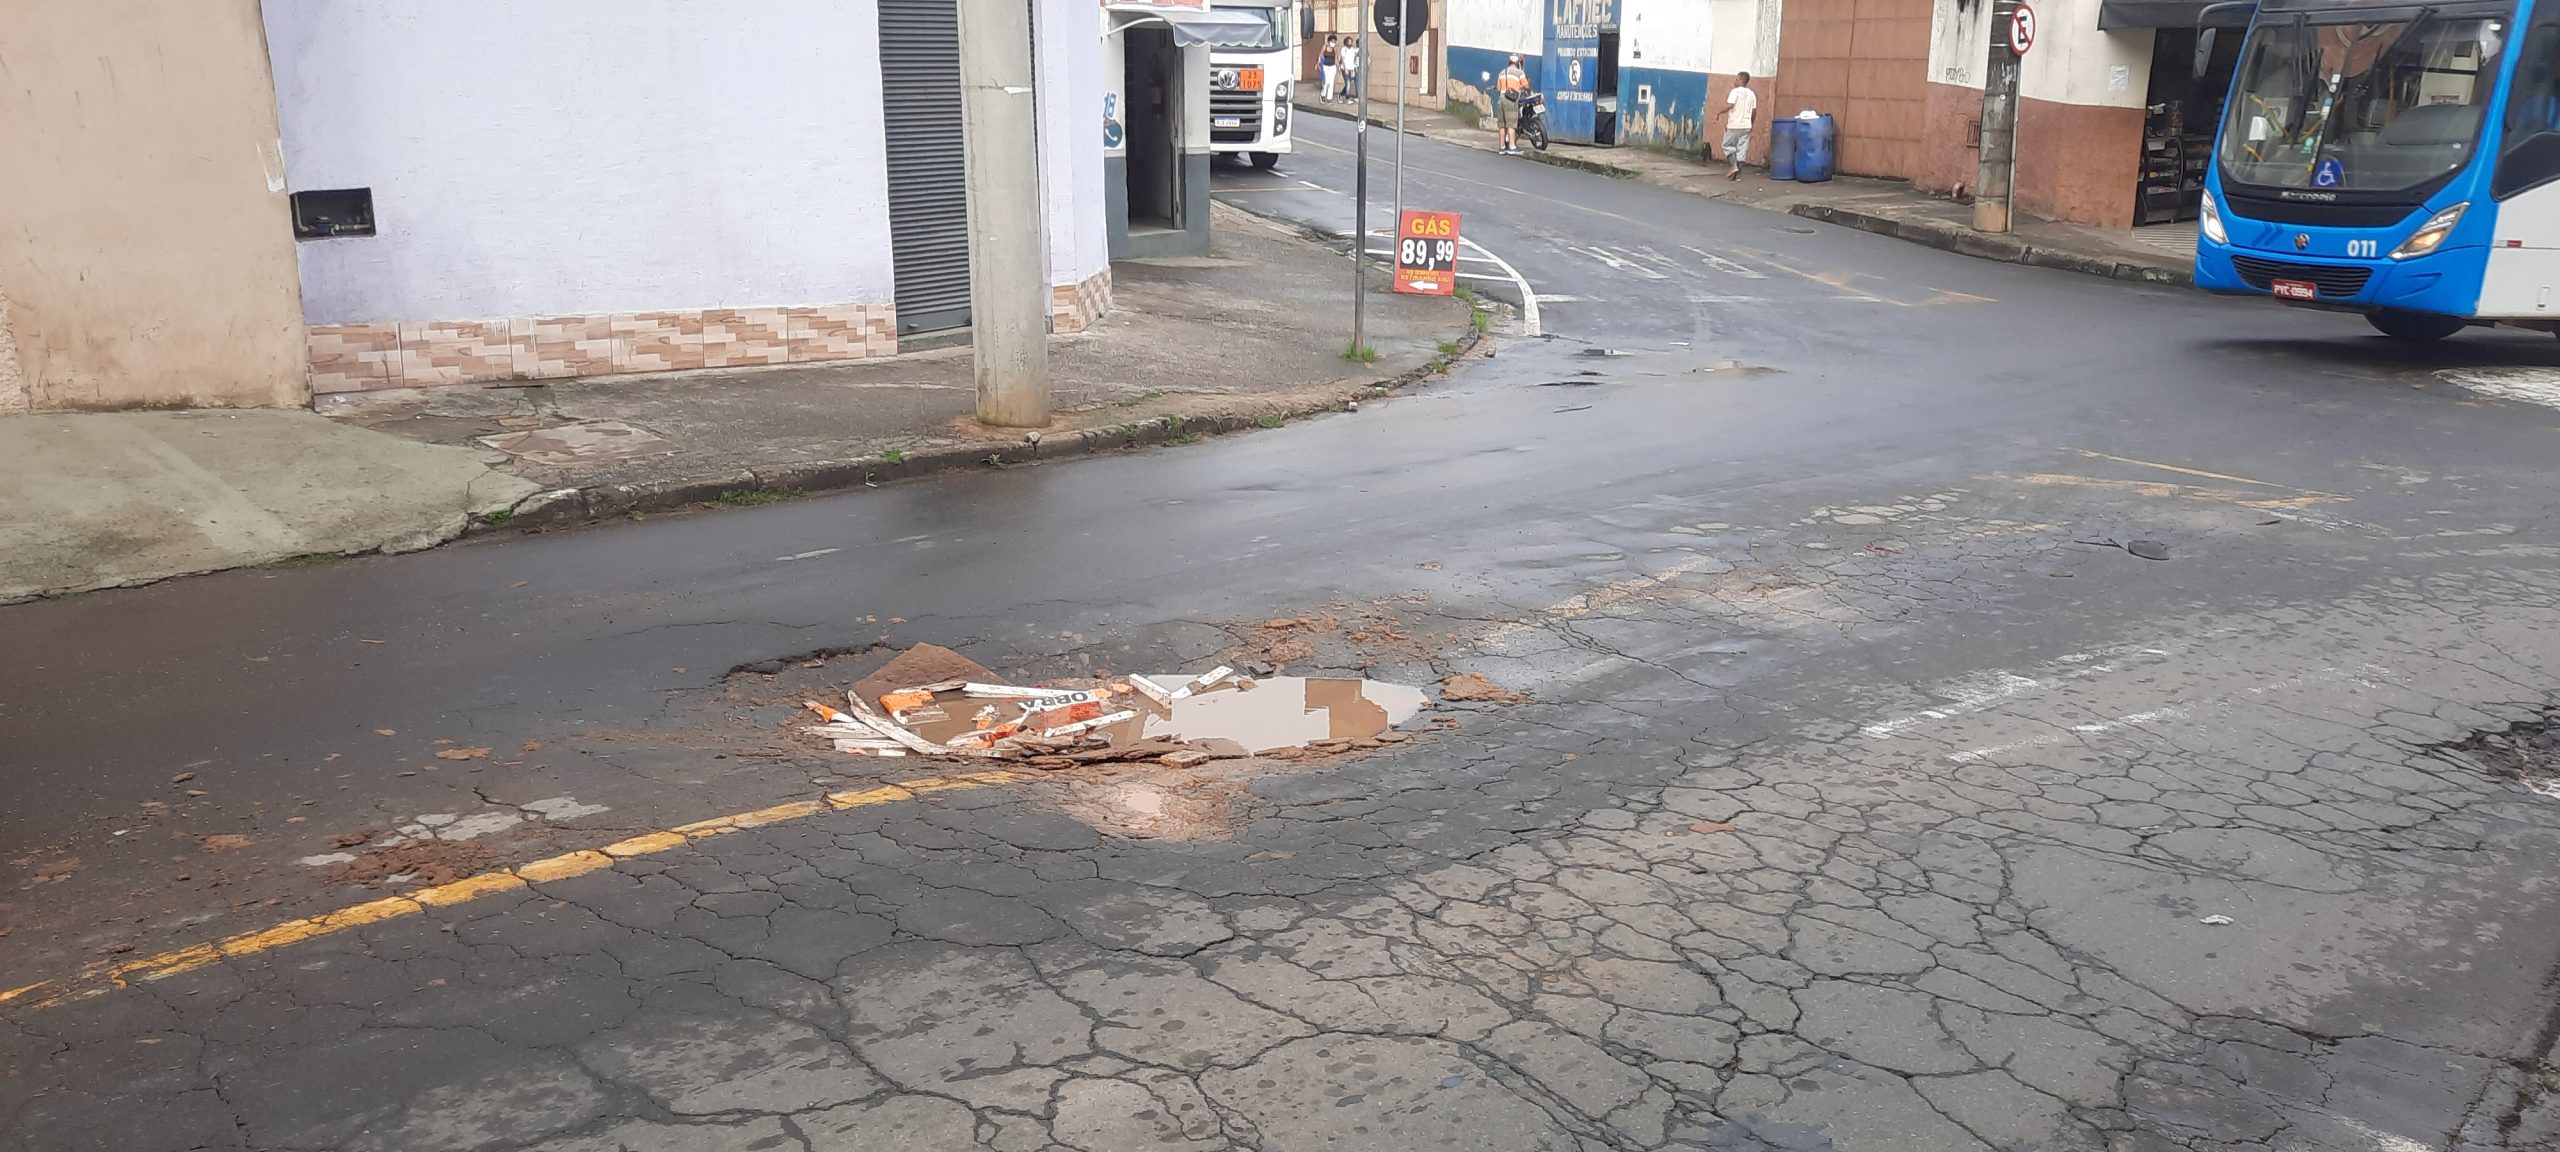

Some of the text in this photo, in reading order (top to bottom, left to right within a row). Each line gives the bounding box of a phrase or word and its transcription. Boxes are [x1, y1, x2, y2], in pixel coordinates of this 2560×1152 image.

[1411, 215, 1451, 236] GÁS
[1401, 239, 1454, 271] 89,99
[2347, 239, 2378, 258] 011
[1023, 692, 1089, 708] OBRA
